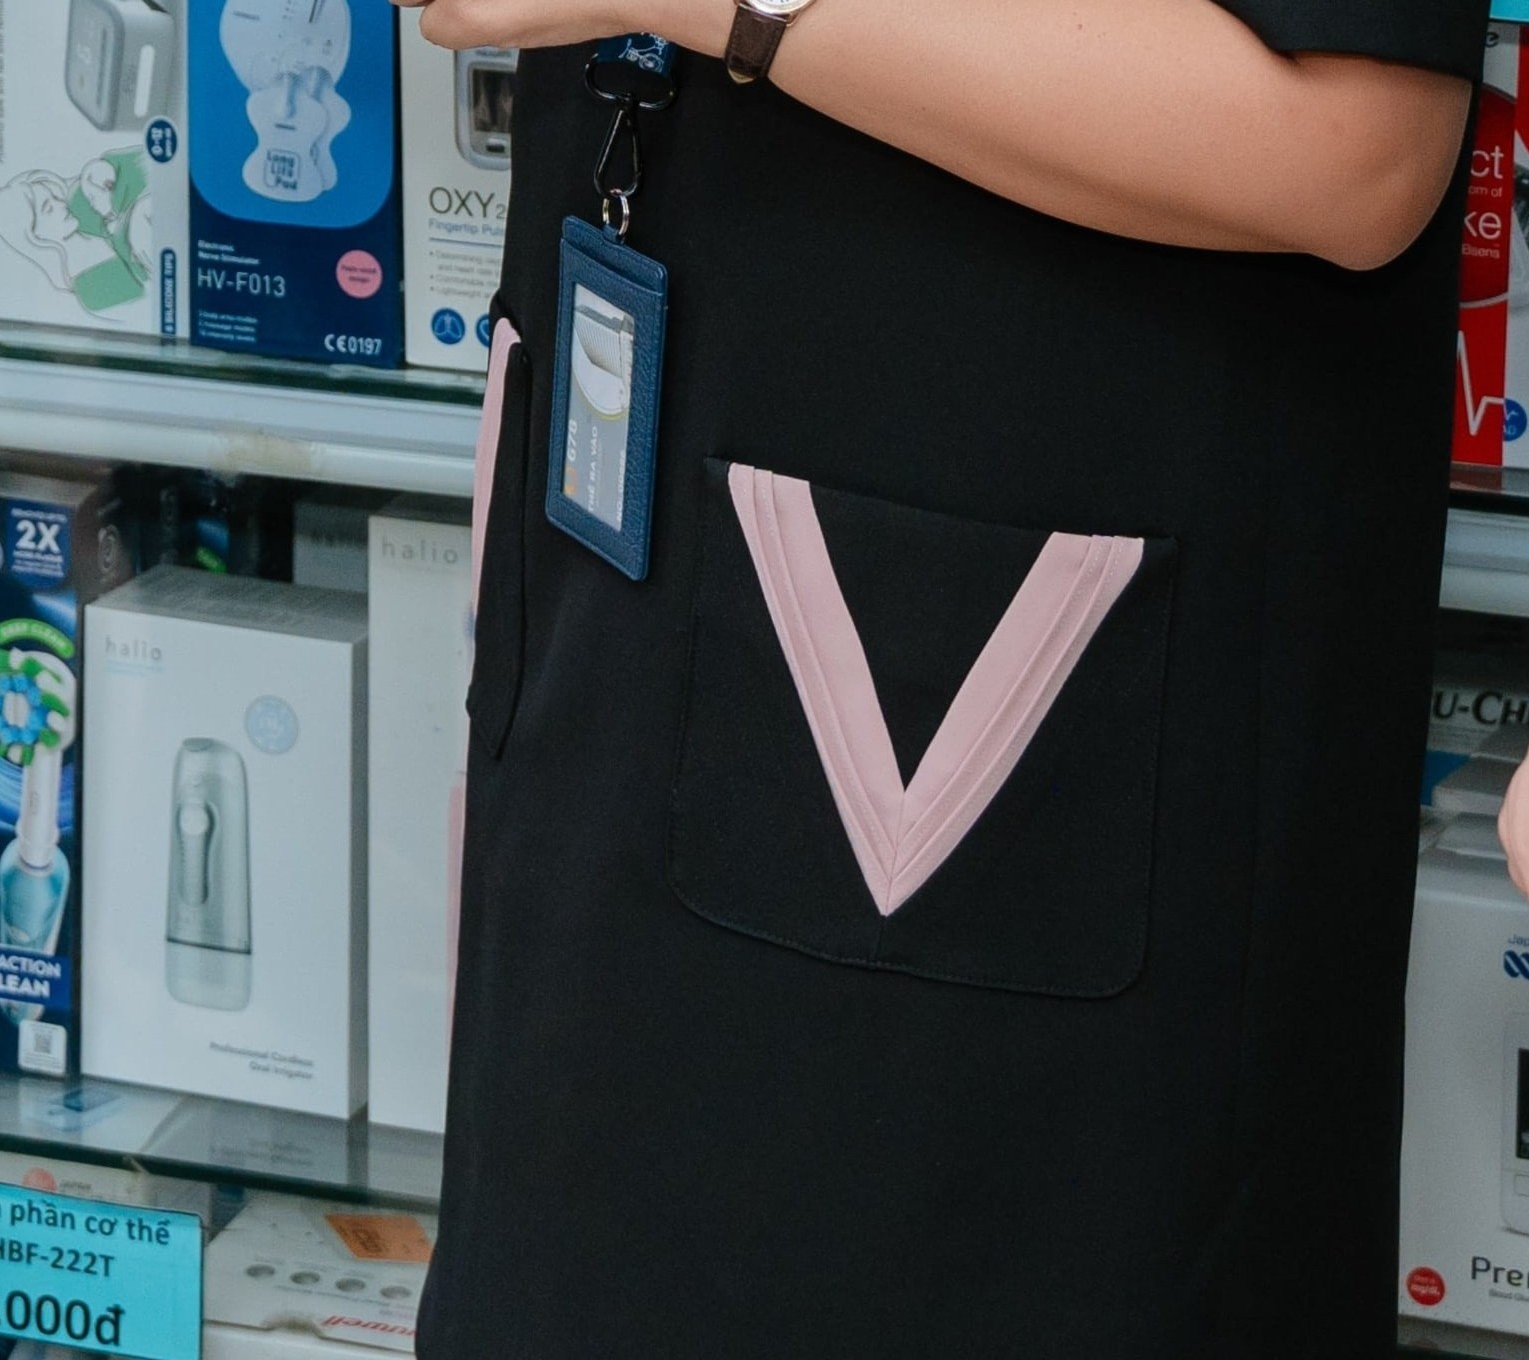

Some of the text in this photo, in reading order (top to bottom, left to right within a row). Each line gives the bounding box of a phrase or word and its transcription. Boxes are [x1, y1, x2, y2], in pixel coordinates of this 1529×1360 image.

[197, 267, 286, 299] HV-F013
[9, 1190, 78, 1236] phần
[85, 1206, 119, 1238] cơ
[124, 1212, 173, 1248] thể
